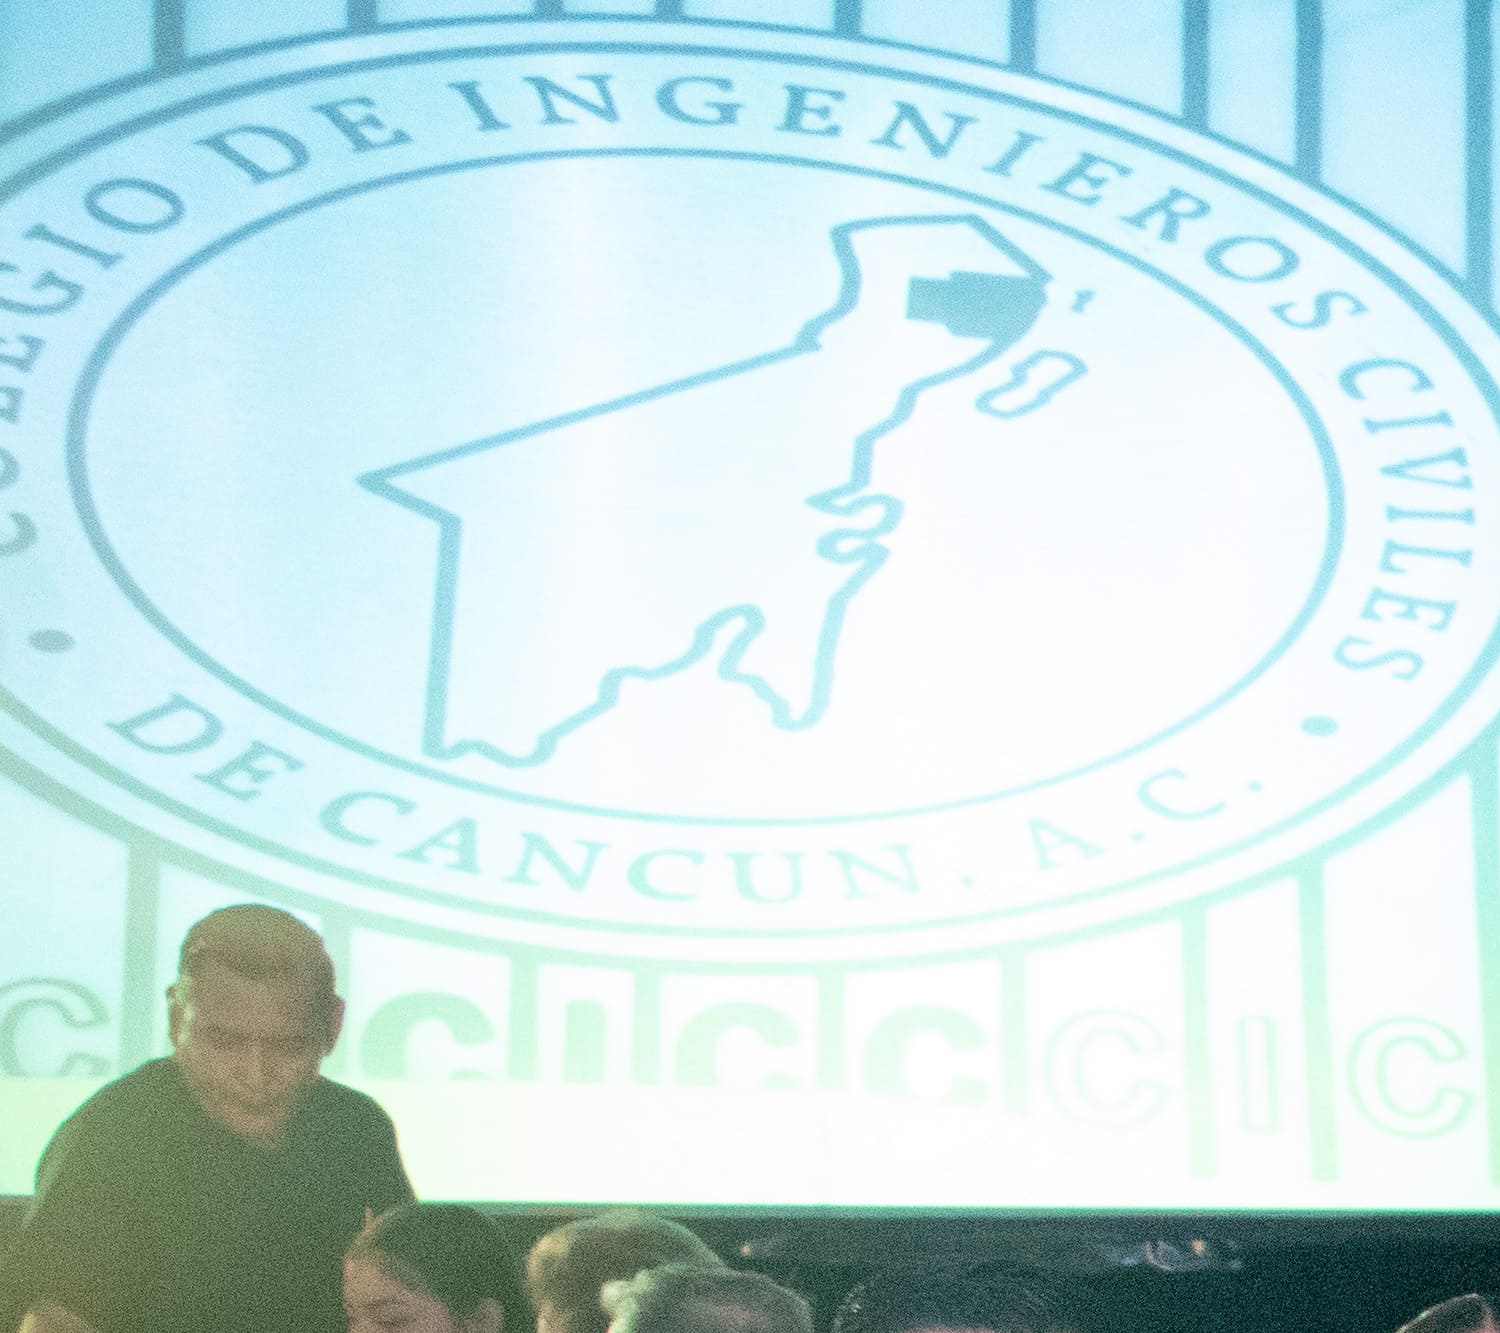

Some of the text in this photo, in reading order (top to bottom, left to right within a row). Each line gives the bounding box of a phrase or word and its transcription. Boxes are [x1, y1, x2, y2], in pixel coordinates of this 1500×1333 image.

[193, 96, 414, 184] DE
[448, 73, 1369, 330] INGENIEROS
[1333, 356, 1476, 682] CIVILES
[103, 692, 307, 803] DE
